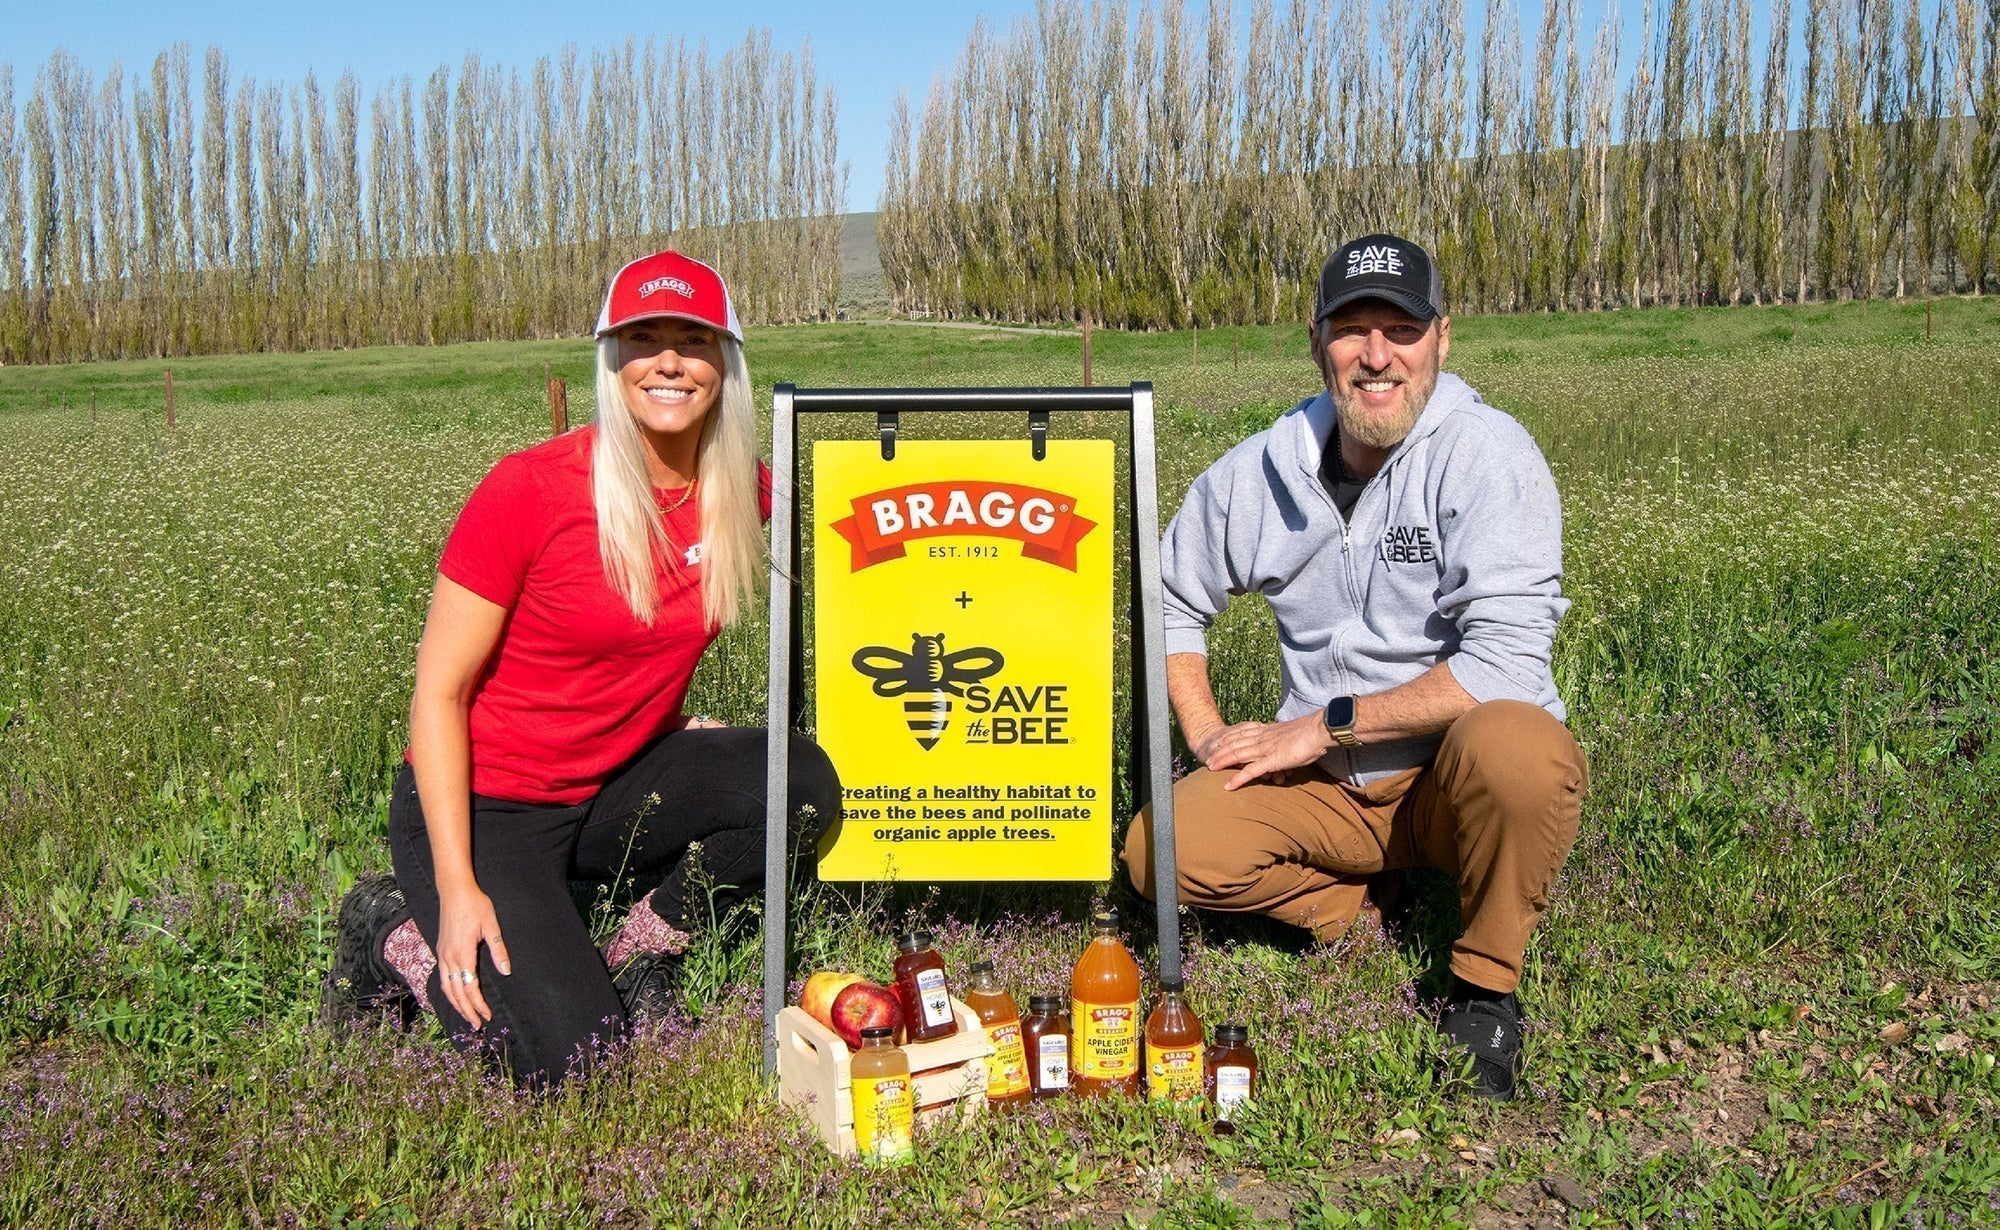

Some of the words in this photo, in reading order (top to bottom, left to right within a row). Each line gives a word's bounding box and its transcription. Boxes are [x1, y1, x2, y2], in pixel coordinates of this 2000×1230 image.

[1348, 246, 1400, 264] SAVE
[1360, 260, 1402, 276] BEE
[646, 279, 687, 291] BRAGG
[1384, 526, 1431, 545] SAVE
[929, 546, 961, 558] EST.
[967, 546, 999, 558] 1912
[1393, 545, 1436, 563] BEE
[965, 686, 1068, 713] SAVE
[965, 718, 990, 738] the
[992, 717, 1069, 745] BEE
[917, 788, 928, 799] a
[933, 785, 1000, 801] healthy
[1007, 785, 1071, 799] habitat
[1077, 787, 1096, 799] to
[838, 807, 881, 819] save
[886, 806, 917, 819] the
[922, 806, 966, 819] bees
[972, 806, 1005, 819] and
[1011, 806, 1091, 821] pollinate
[873, 826, 941, 842] organic
[947, 826, 996, 842] apple
[1003, 827, 1056, 840] trees.
[1095, 1009, 1129, 1018] BRAGG
[1087, 1038, 1111, 1047] APPLE
[1114, 1036, 1134, 1047] CIDER
[1095, 1046, 1128, 1055] VINEGAR
